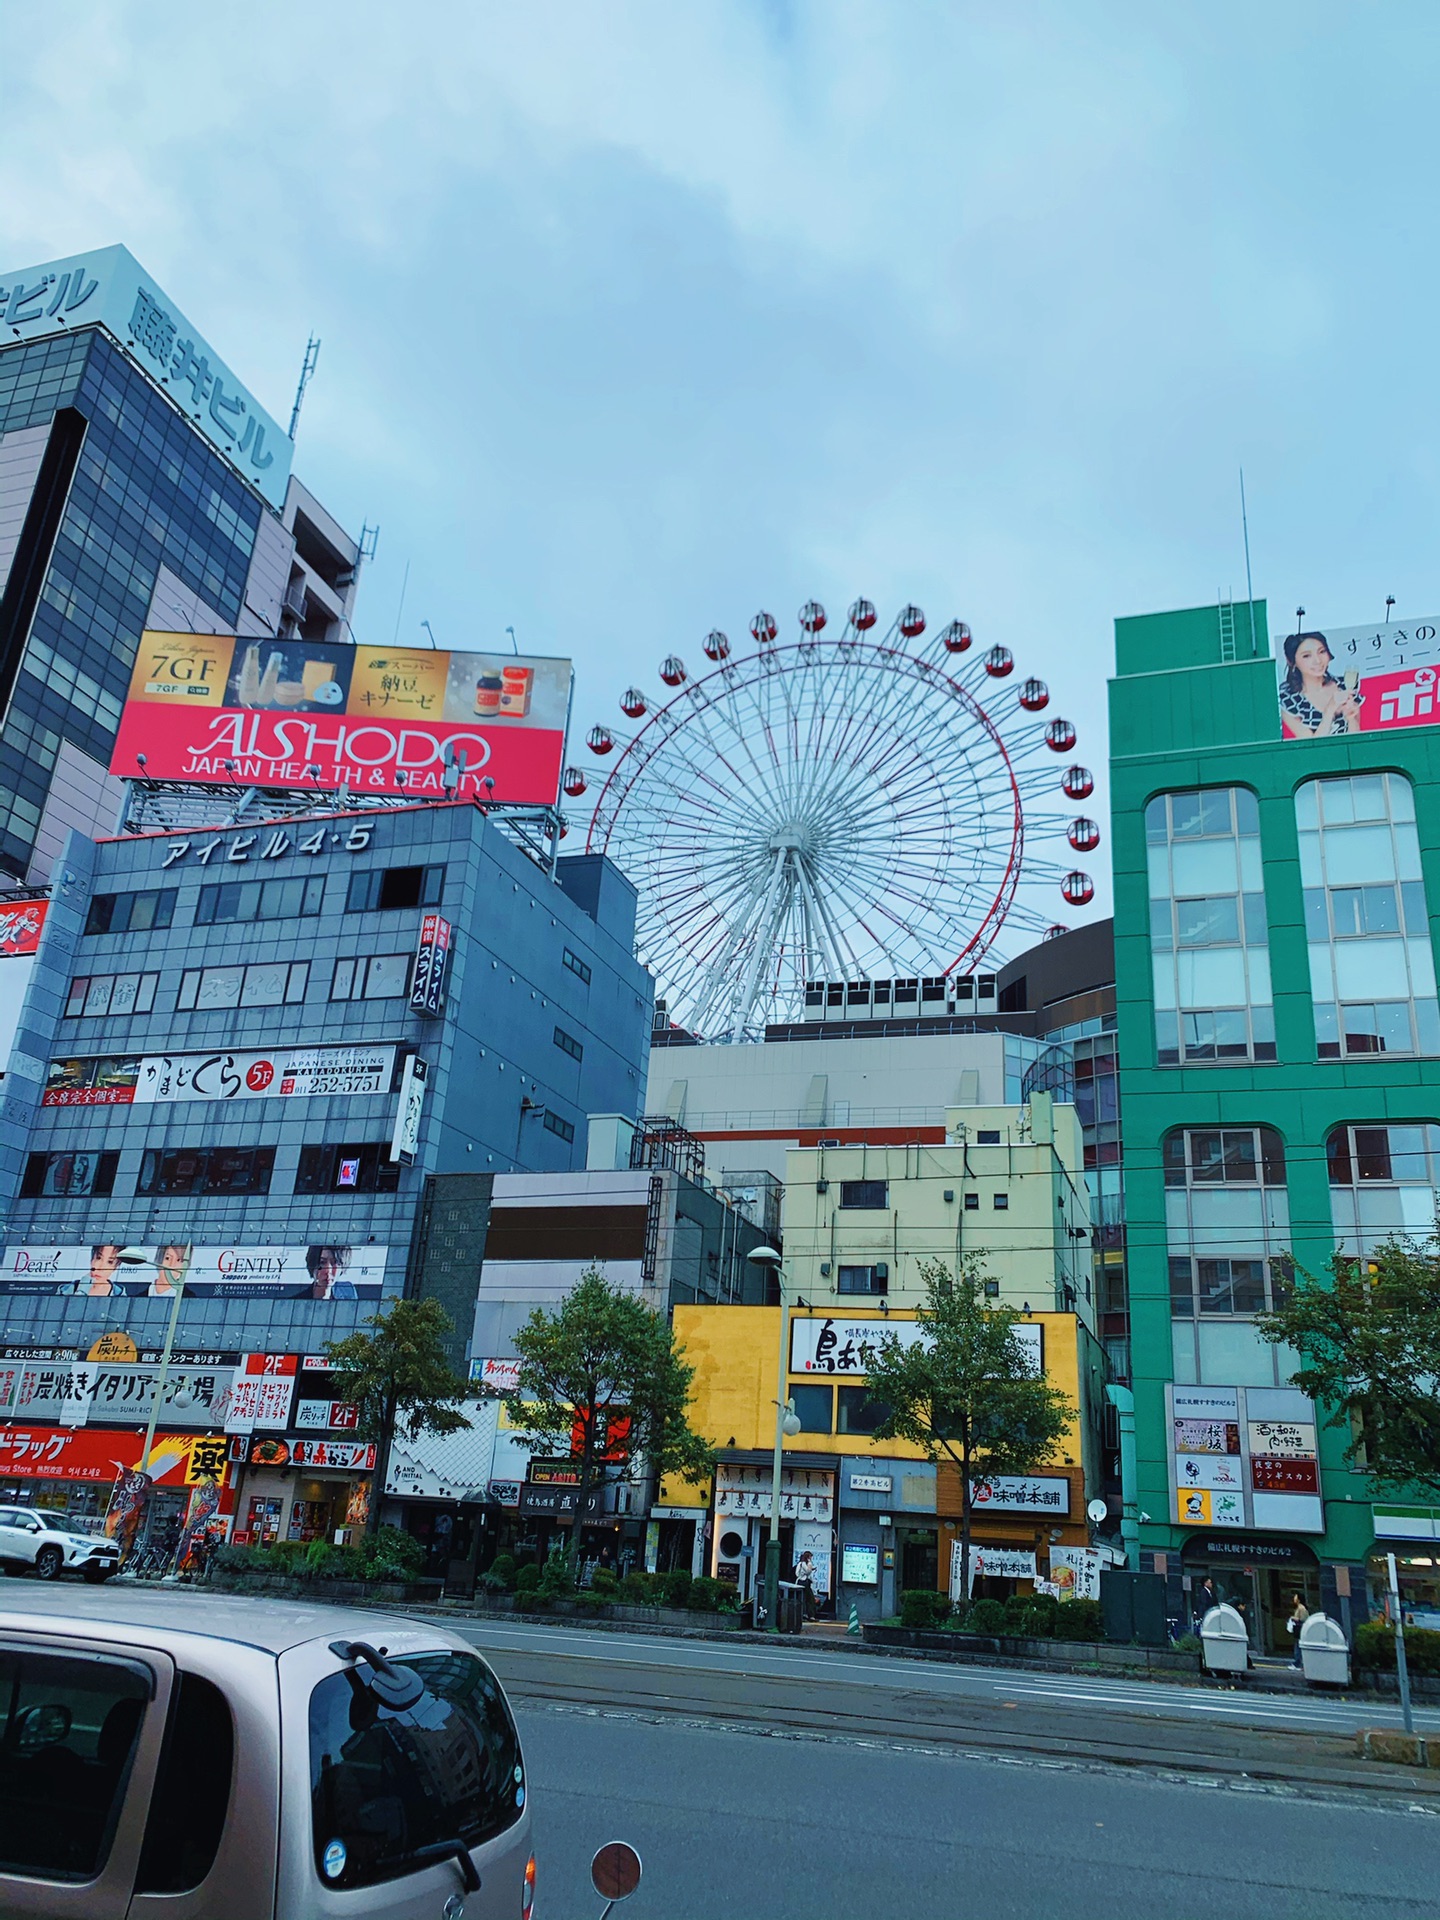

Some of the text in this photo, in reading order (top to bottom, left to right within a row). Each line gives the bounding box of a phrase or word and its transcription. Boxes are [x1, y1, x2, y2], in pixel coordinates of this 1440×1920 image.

[128, 286, 274, 470] 藤井ビル
[1343, 626, 1436, 655] すすきの
[151, 655, 217, 681] 7GF
[1365, 648, 1440, 672] ニュー
[156, 684, 179, 693] 7GF
[1379, 667, 1440, 722] ポ
[360, 690, 436, 710] キナーゼ
[187, 712, 491, 773] AISHODO
[182, 755, 260, 777] JAPAN
[268, 761, 362, 784] HEALTH
[368, 768, 386, 786] &
[412, 946, 431, 1004] スライム
[285, 1057, 385, 1069] JAPANESE DINING
[296, 1067, 370, 1077] KAMADOKURA
[249, 1064, 272, 1086] 5F
[308, 1075, 382, 1094] 252-5751
[45, 1089, 120, 1106] 全席完全個室
[218, 1250, 288, 1273] GENTLY
[264, 1355, 285, 1375] 2F
[1207, 1424, 1224, 1452] 桜坂
[12, 1464, 33, 1474] Store
[193, 1441, 228, 1482] 薬
[401, 1472, 422, 1480] INITIAL
[1256, 1471, 1312, 1481] ジンギスカン
[559, 1496, 596, 1511] 直り
[993, 1490, 1061, 1506] 味噌本舗
